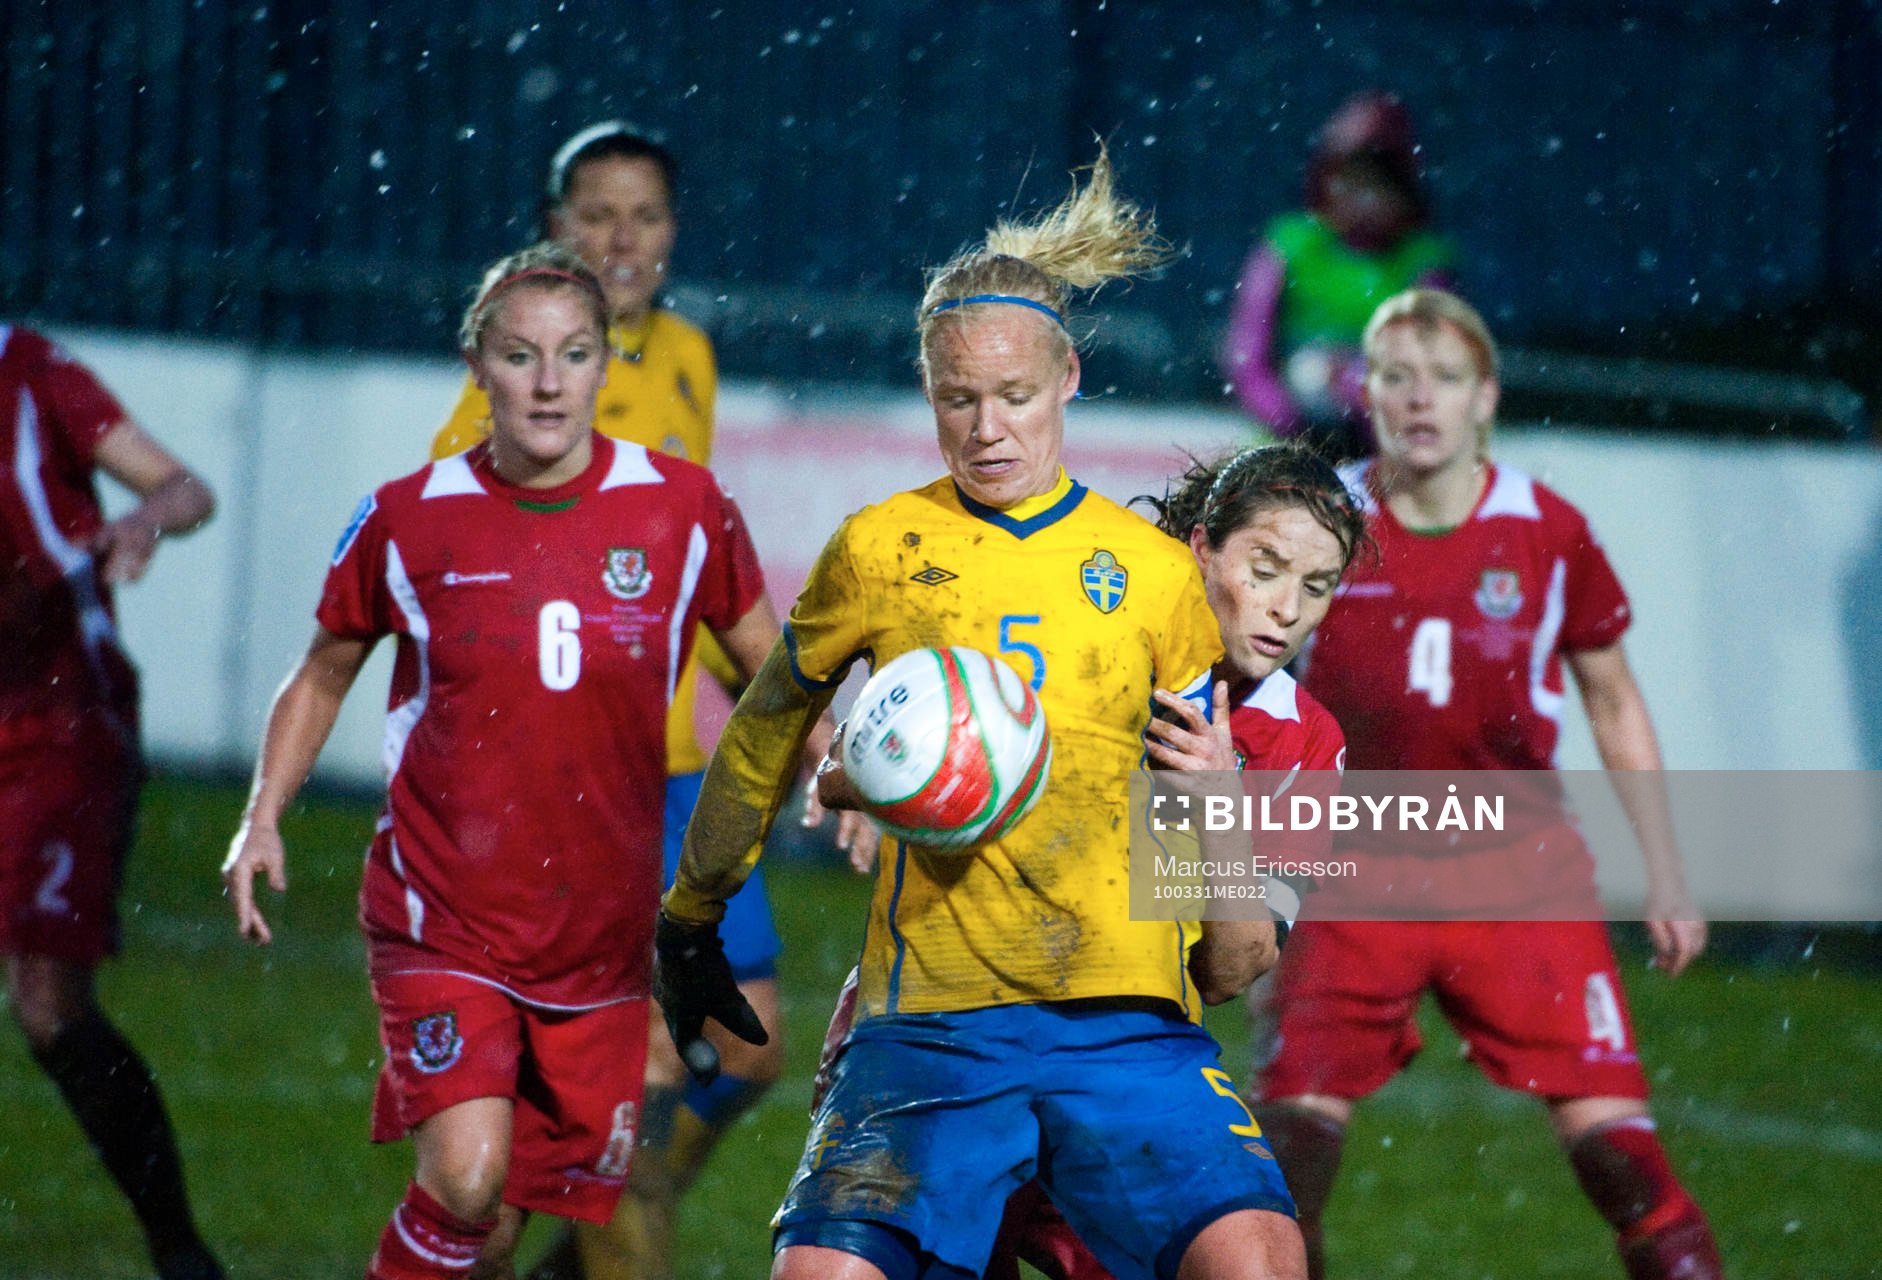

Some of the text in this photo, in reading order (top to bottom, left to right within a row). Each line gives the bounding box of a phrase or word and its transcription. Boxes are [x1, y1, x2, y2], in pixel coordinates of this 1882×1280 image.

[538, 599, 581, 692] 6
[999, 614, 1046, 692] 5
[1408, 617, 1453, 707] 4
[37, 840, 74, 913] 2
[1585, 972, 1625, 1051] 4
[596, 1101, 635, 1176] 6
[1200, 1066, 1262, 1138] 5
